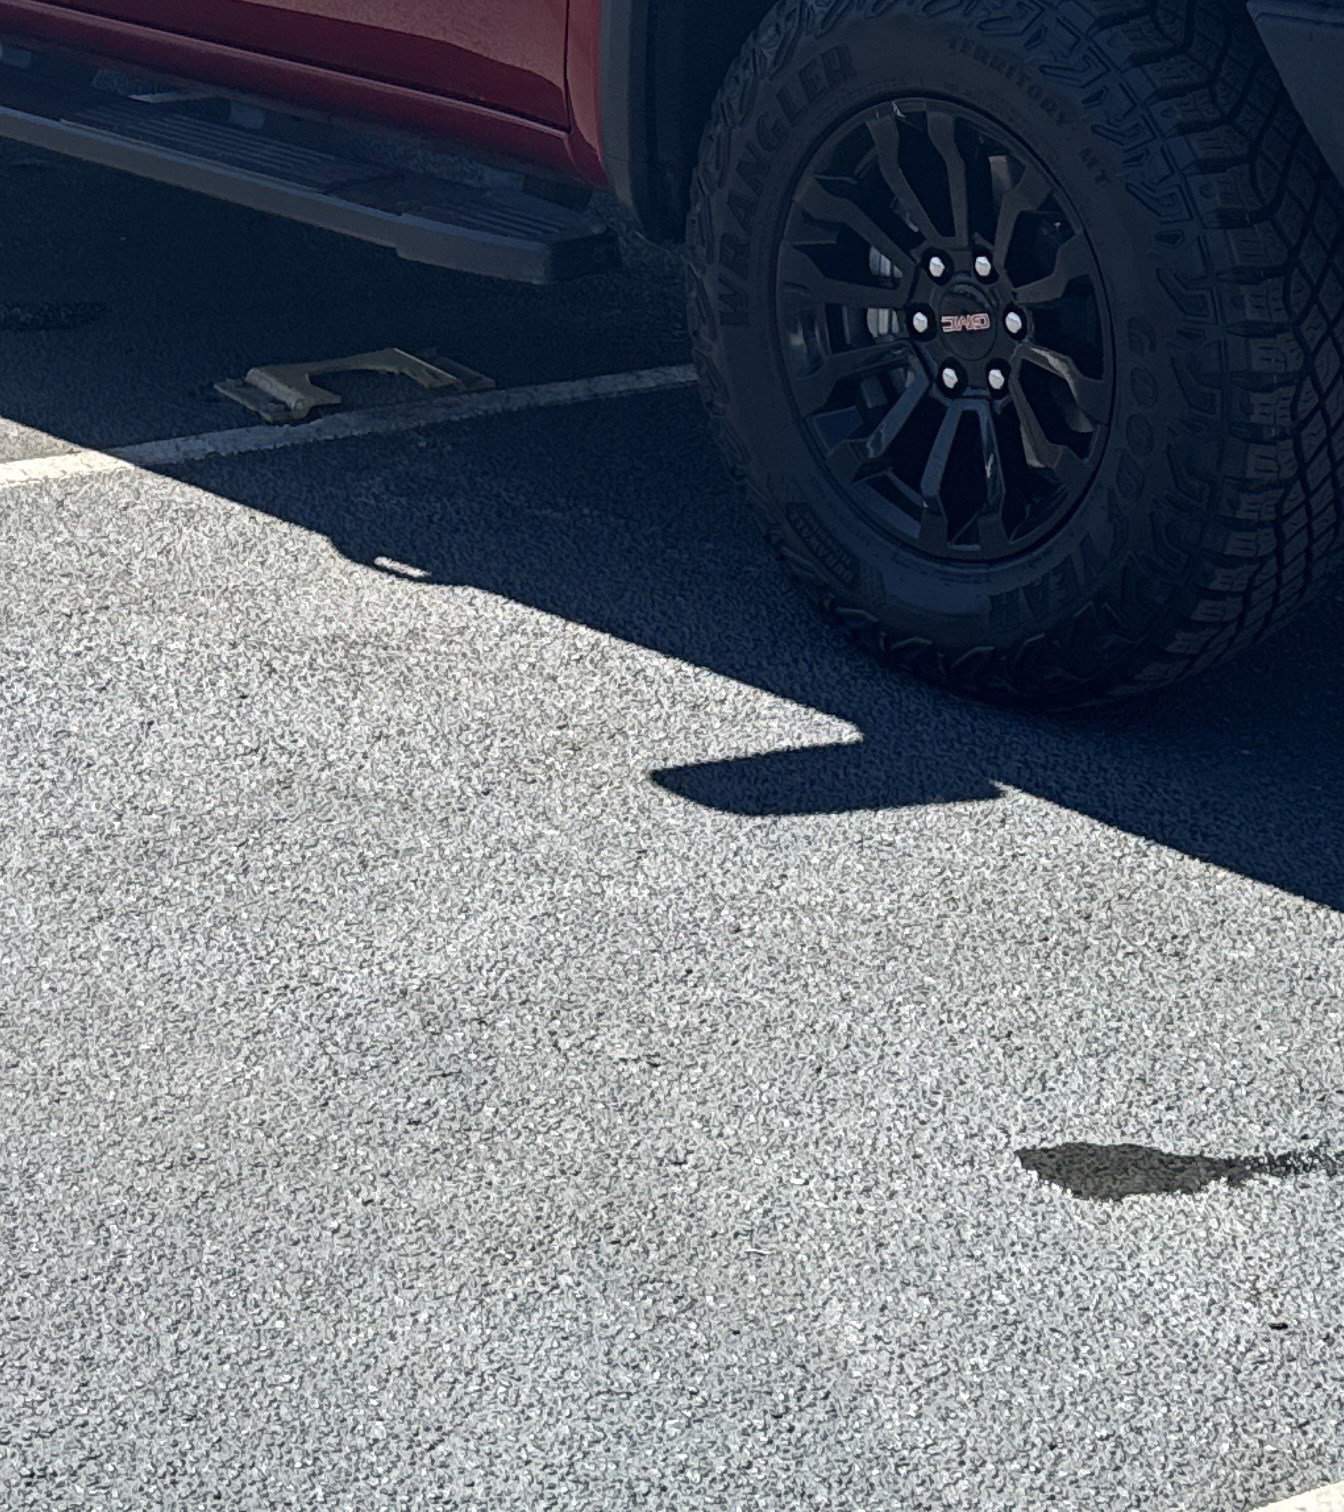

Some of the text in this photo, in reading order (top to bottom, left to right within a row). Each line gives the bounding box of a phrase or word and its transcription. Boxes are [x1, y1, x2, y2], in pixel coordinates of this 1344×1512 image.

[948, 34, 1070, 127] TERRITORY
[718, 43, 858, 327] WRANGLER
[941, 313, 991, 333] GMC
